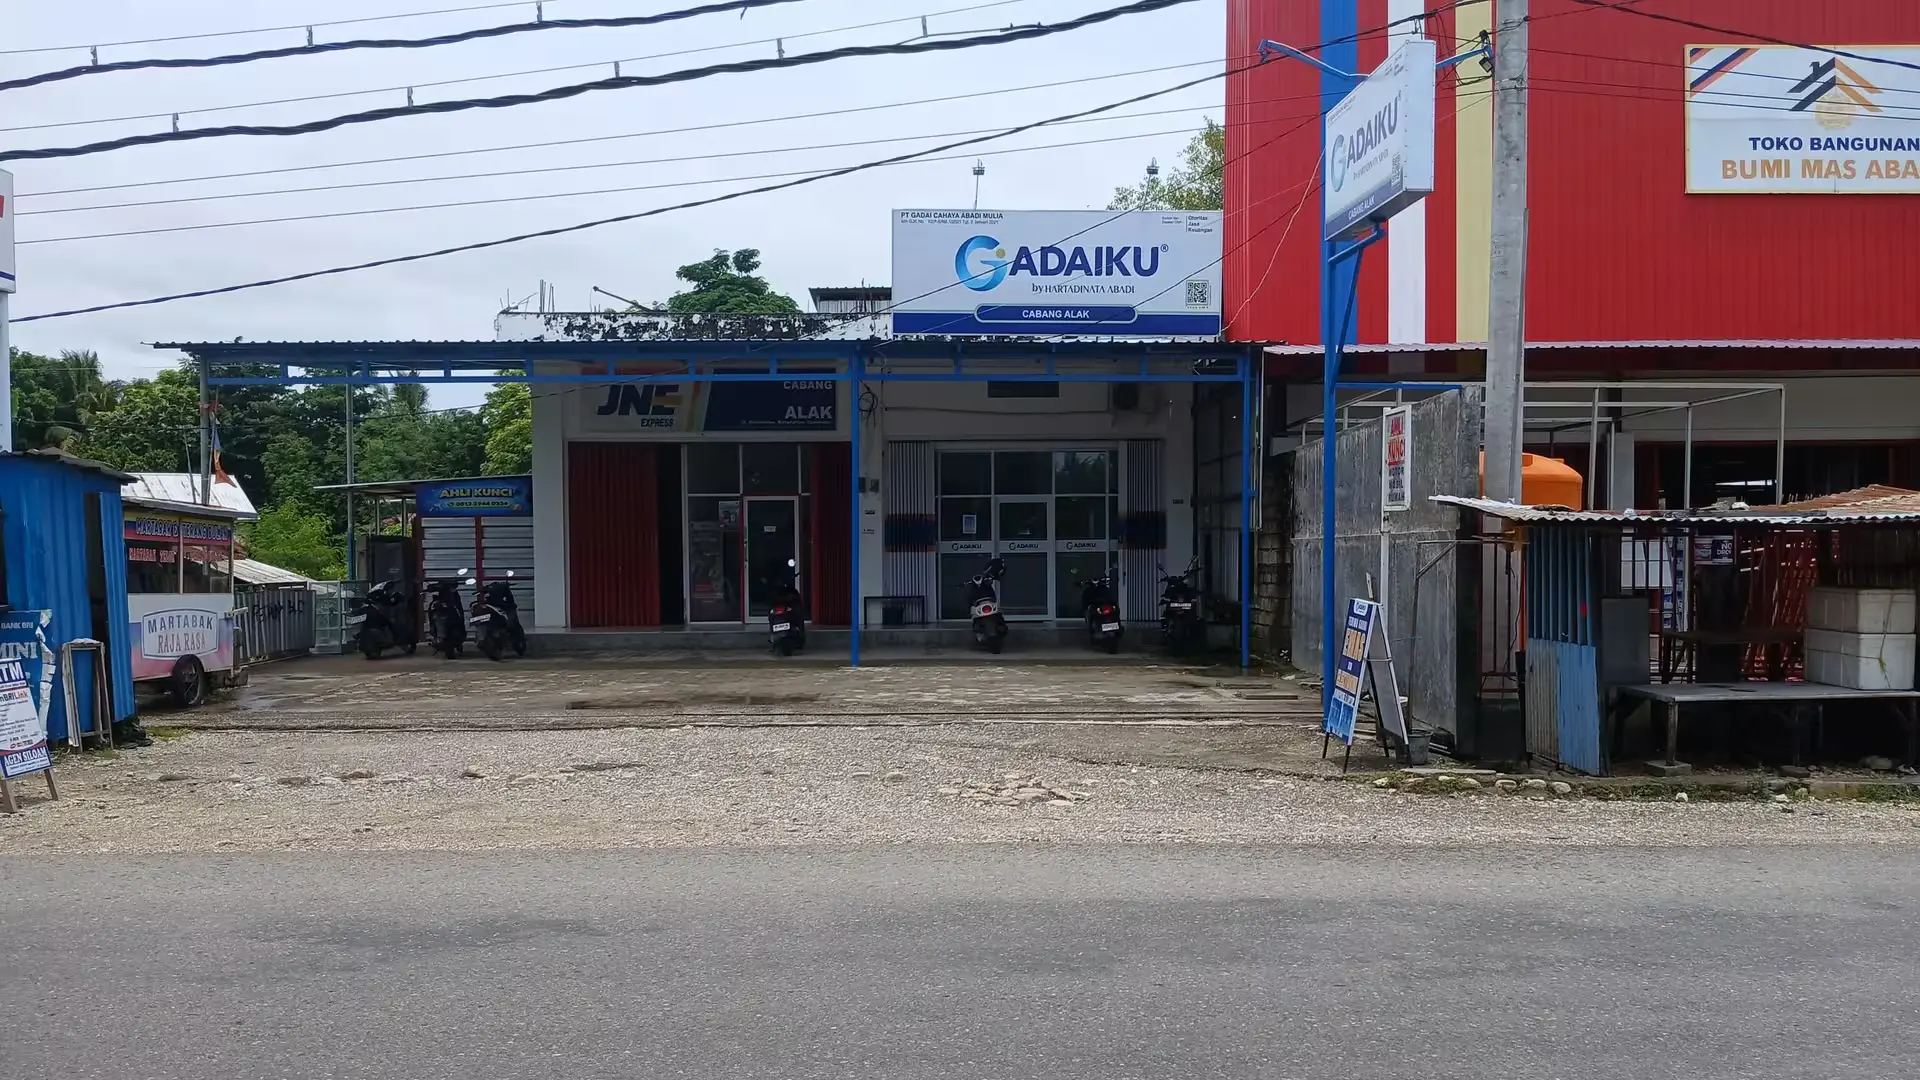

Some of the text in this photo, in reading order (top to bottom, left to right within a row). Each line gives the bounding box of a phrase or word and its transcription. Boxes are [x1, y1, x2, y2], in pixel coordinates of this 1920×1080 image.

[1331, 97, 1399, 192] GADAIKU
[1749, 137, 1920, 151] TOKO BANGUNAN
[1722, 159, 1790, 180] BUMI
[1801, 159, 1857, 180] MAS
[1032, 283, 1135, 294] by HARTADINATA ABADI
[1022, 309, 1090, 318] CABANG ALAK
[783, 381, 833, 390] CABANG
[597, 384, 683, 416] JNE
[784, 405, 833, 419] ALAK
[641, 418, 674, 427] EXPRESS
[1388, 437, 1406, 460] KUNCI
[440, 488, 513, 498] AHLI KUNCI
[952, 543, 982, 551] GADAIKU
[1008, 542, 1039, 550] GADAIKU
[1066, 541, 1097, 550] GADAIKU
[1, 621, 33, 630] BANK BRI
[148, 616, 213, 634] MARTABAK
[157, 631, 206, 654] RAJA RASA
[0, 661, 25, 683] TM
[4, 746, 48, 767] AGEN SILOAM
